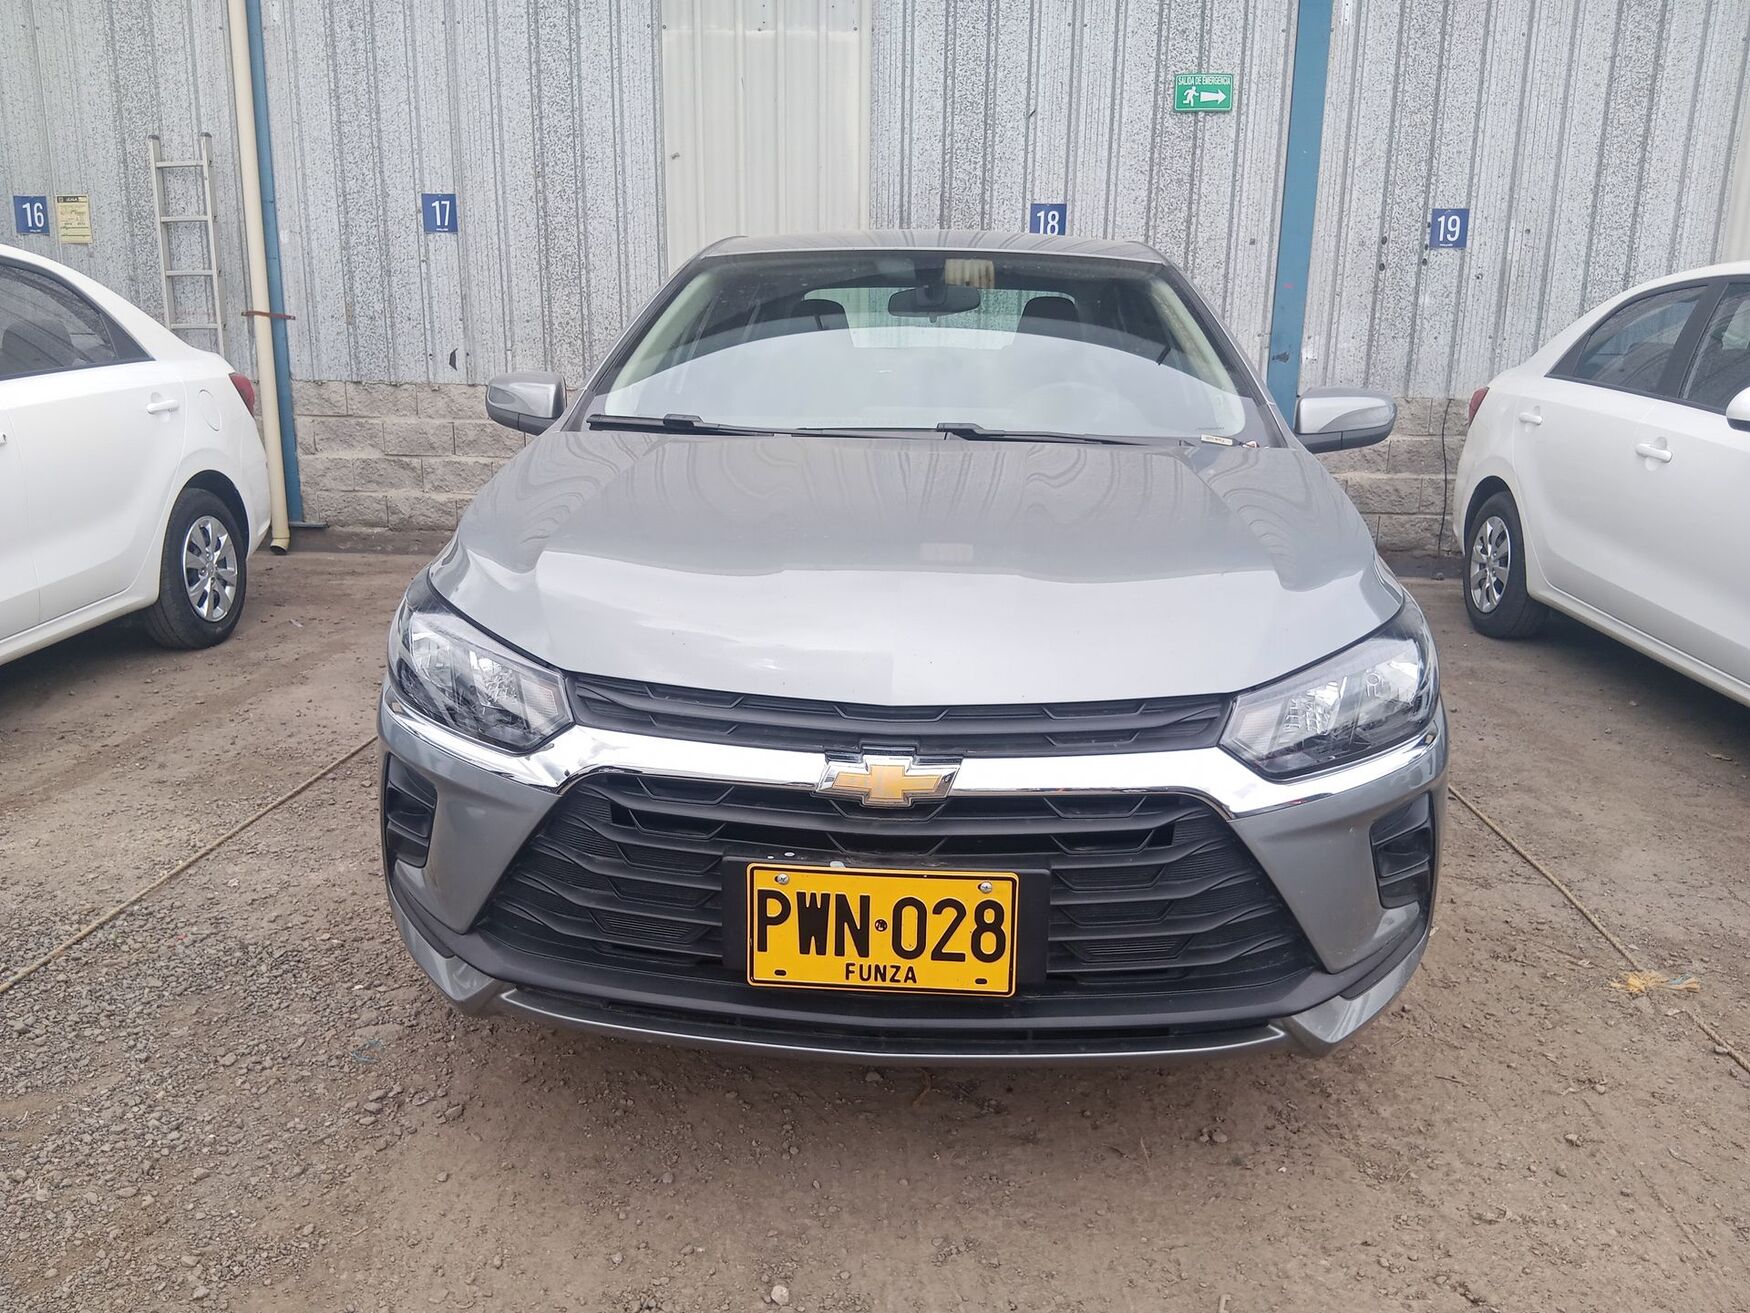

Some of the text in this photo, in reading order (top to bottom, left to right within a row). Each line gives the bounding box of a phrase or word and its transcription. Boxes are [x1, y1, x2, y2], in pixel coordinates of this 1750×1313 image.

[1178, 76, 1231, 85] SALIDA DE EMERGENCIA
[22, 202, 45, 228] 16
[431, 200, 450, 226] 17
[1036, 210, 1060, 236] 18
[1437, 215, 1461, 242] 19
[845, 962, 918, 984] FUNZA
